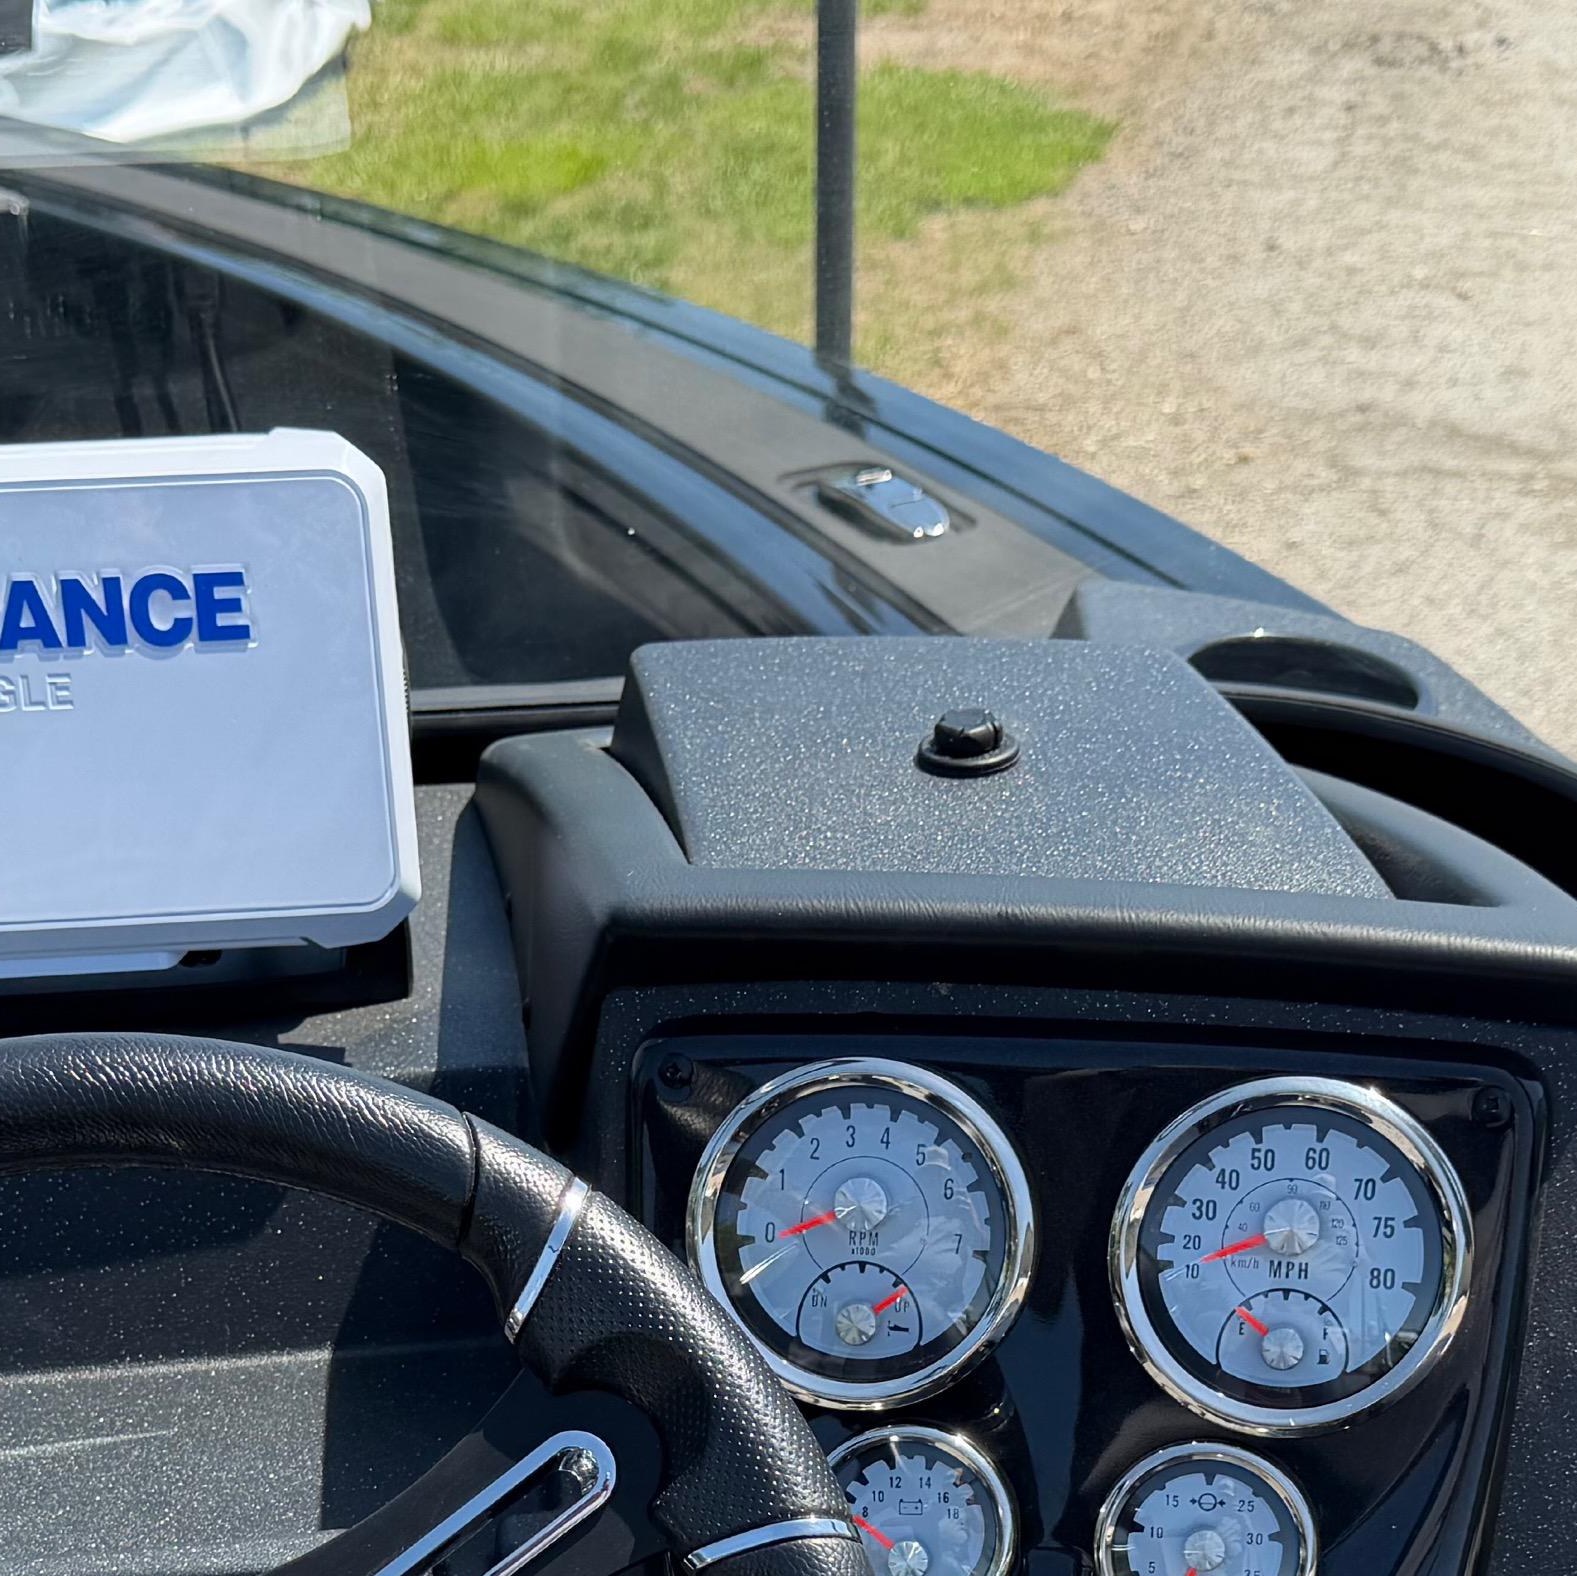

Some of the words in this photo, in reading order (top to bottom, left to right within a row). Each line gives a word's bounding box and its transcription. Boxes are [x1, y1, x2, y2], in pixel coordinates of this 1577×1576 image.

[846, 1125, 855, 1148] 3
[880, 1127, 891, 1149] 4
[810, 1138, 820, 1160] 2
[916, 1144, 926, 1166] 5
[1250, 1148, 1275, 1172] 50
[1305, 1147, 1330, 1171] 60
[779, 1169, 785, 1190] 1
[1216, 1169, 1240, 1191] 40
[944, 1178, 954, 1200] 6
[1287, 1184, 1298, 1195] 90
[1353, 1178, 1376, 1201] 70
[1191, 1199, 1217, 1221] 30
[1249, 1202, 1261, 1213] 60
[1238, 1222, 1248, 1232] 40
[1331, 1218, 1345, 1229] 120
[1373, 1217, 1395, 1239] 75
[765, 1222, 775, 1243] 0
[849, 1230, 879, 1248] RPM
[954, 1234, 963, 1255] 7
[1182, 1234, 1201, 1250] 20
[1185, 1263, 1200, 1279] 10
[1230, 1256, 1260, 1270] km/h
[1268, 1259, 1309, 1280] MPH
[1369, 1268, 1395, 1290] 80
[1239, 1322, 1246, 1335] E
[889, 1476, 902, 1489] 12
[919, 1476, 932, 1489] 14
[872, 1490, 885, 1503] 10
[937, 1491, 950, 1504] 16
[1165, 1494, 1179, 1507] 15
[862, 1506, 869, 1518] 8
[947, 1508, 960, 1520] 18
[1237, 1500, 1255, 1513] 25
[1150, 1526, 1164, 1539] 10
[1246, 1532, 1263, 1546] 30
[1148, 1561, 1156, 1575] 5
